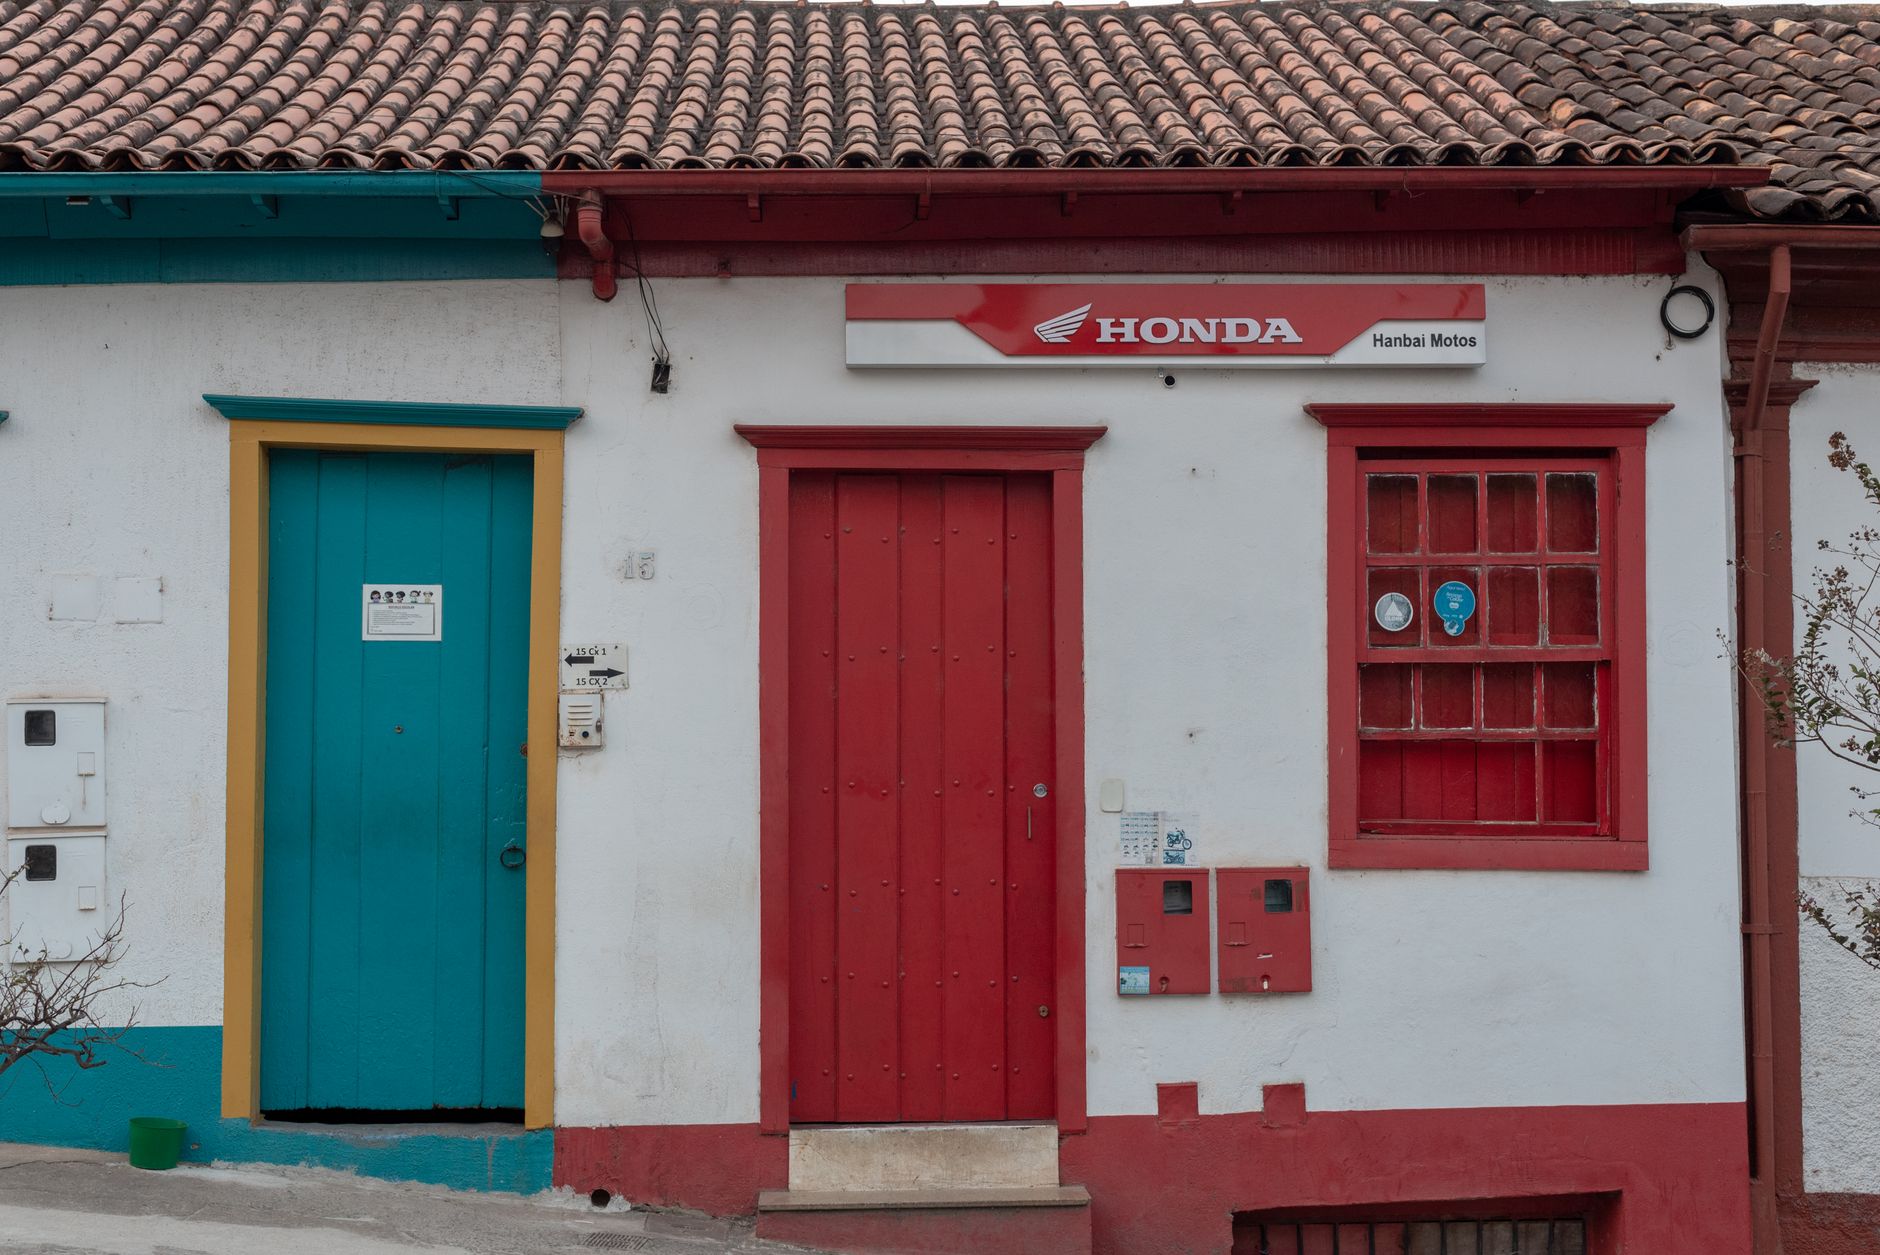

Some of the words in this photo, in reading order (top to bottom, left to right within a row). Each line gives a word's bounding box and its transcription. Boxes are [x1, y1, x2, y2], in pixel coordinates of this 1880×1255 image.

[1096, 317, 1303, 344] HONDA
[1373, 333, 1426, 348] Hanbai
[1430, 333, 1477, 348] Motos
[624, 552, 655, 580] 15
[576, 647, 587, 656] 15
[601, 647, 607, 656] 1
[576, 677, 587, 686] 15
[602, 677, 608, 686] 2
